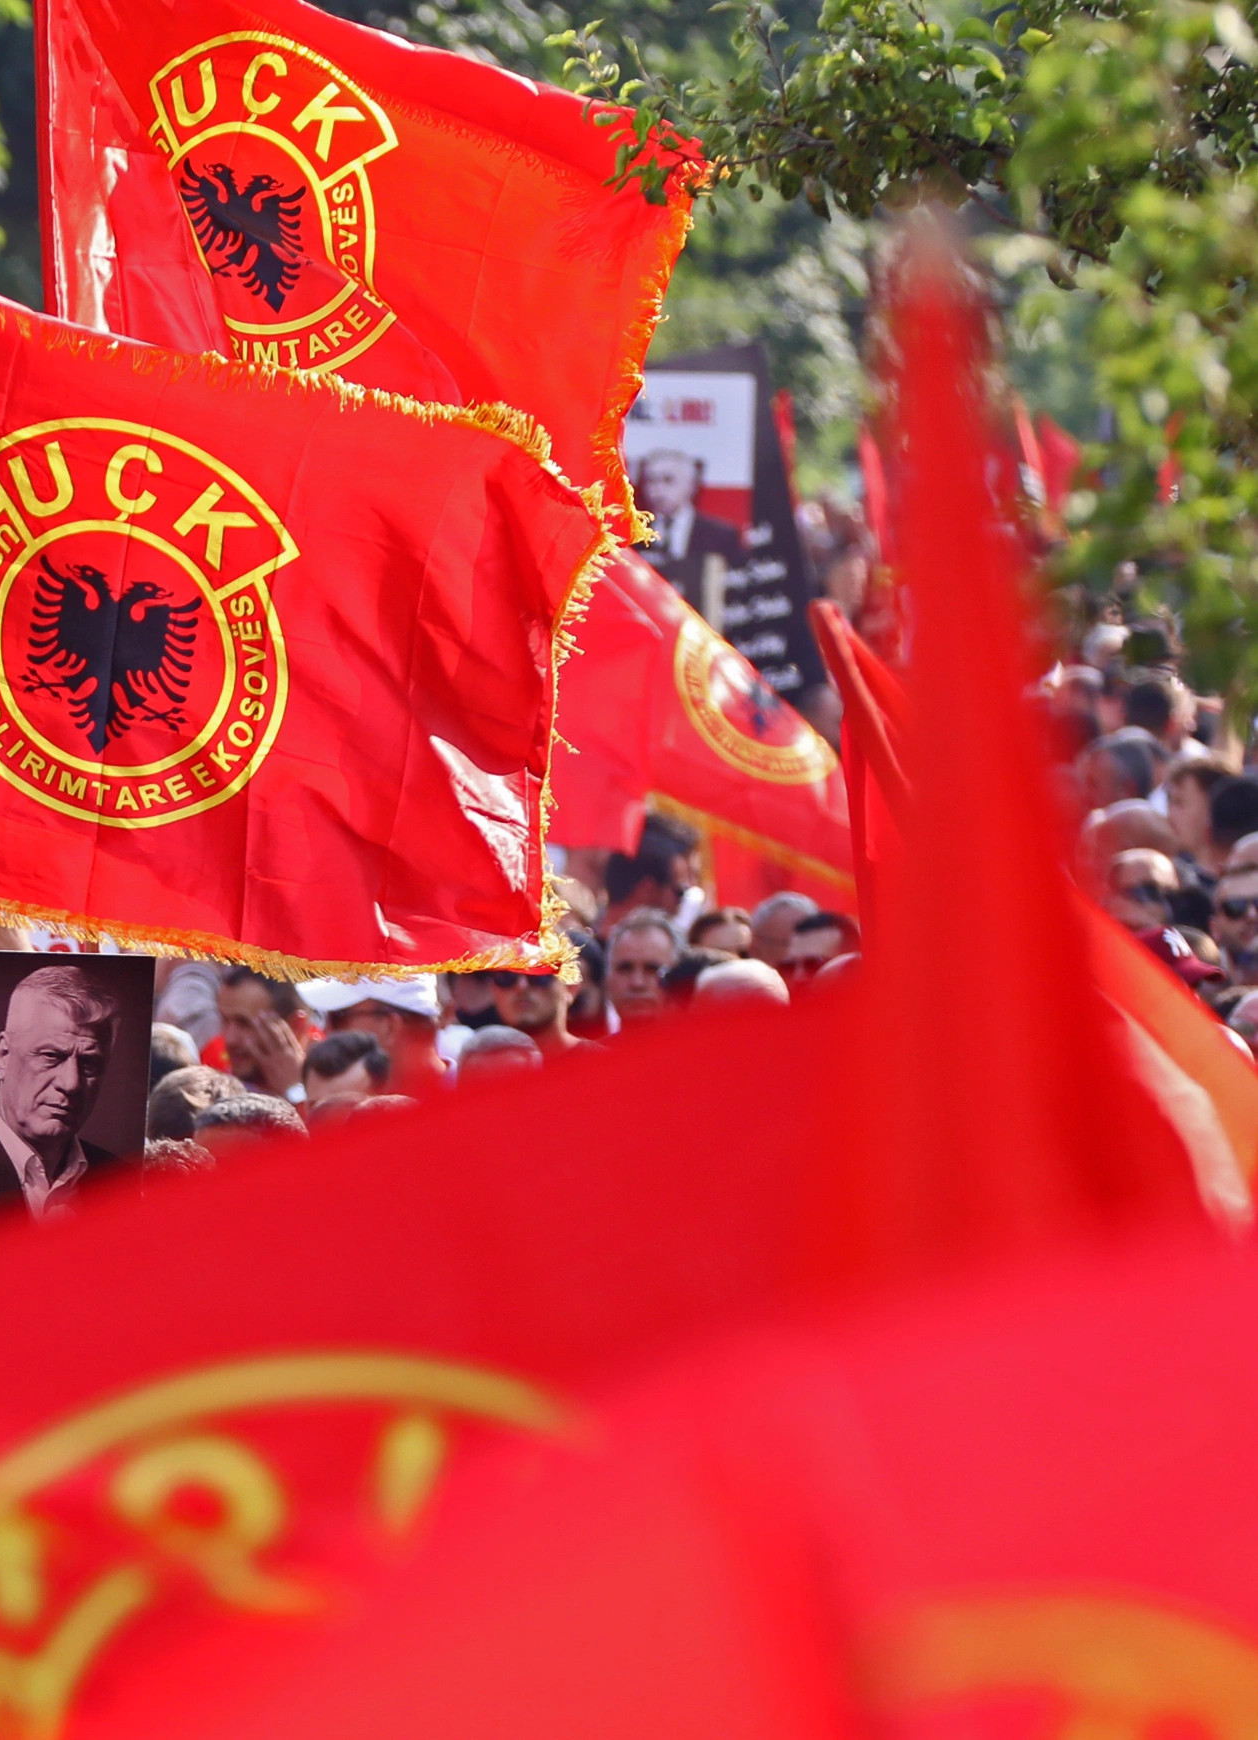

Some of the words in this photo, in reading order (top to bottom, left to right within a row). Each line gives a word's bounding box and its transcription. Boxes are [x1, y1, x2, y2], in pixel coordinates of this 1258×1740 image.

[170, 52, 366, 162] UÇK
[8, 440, 259, 571] UÇK
[195, 762, 216, 787] E
[208, 595, 270, 773] KOSOVËS
